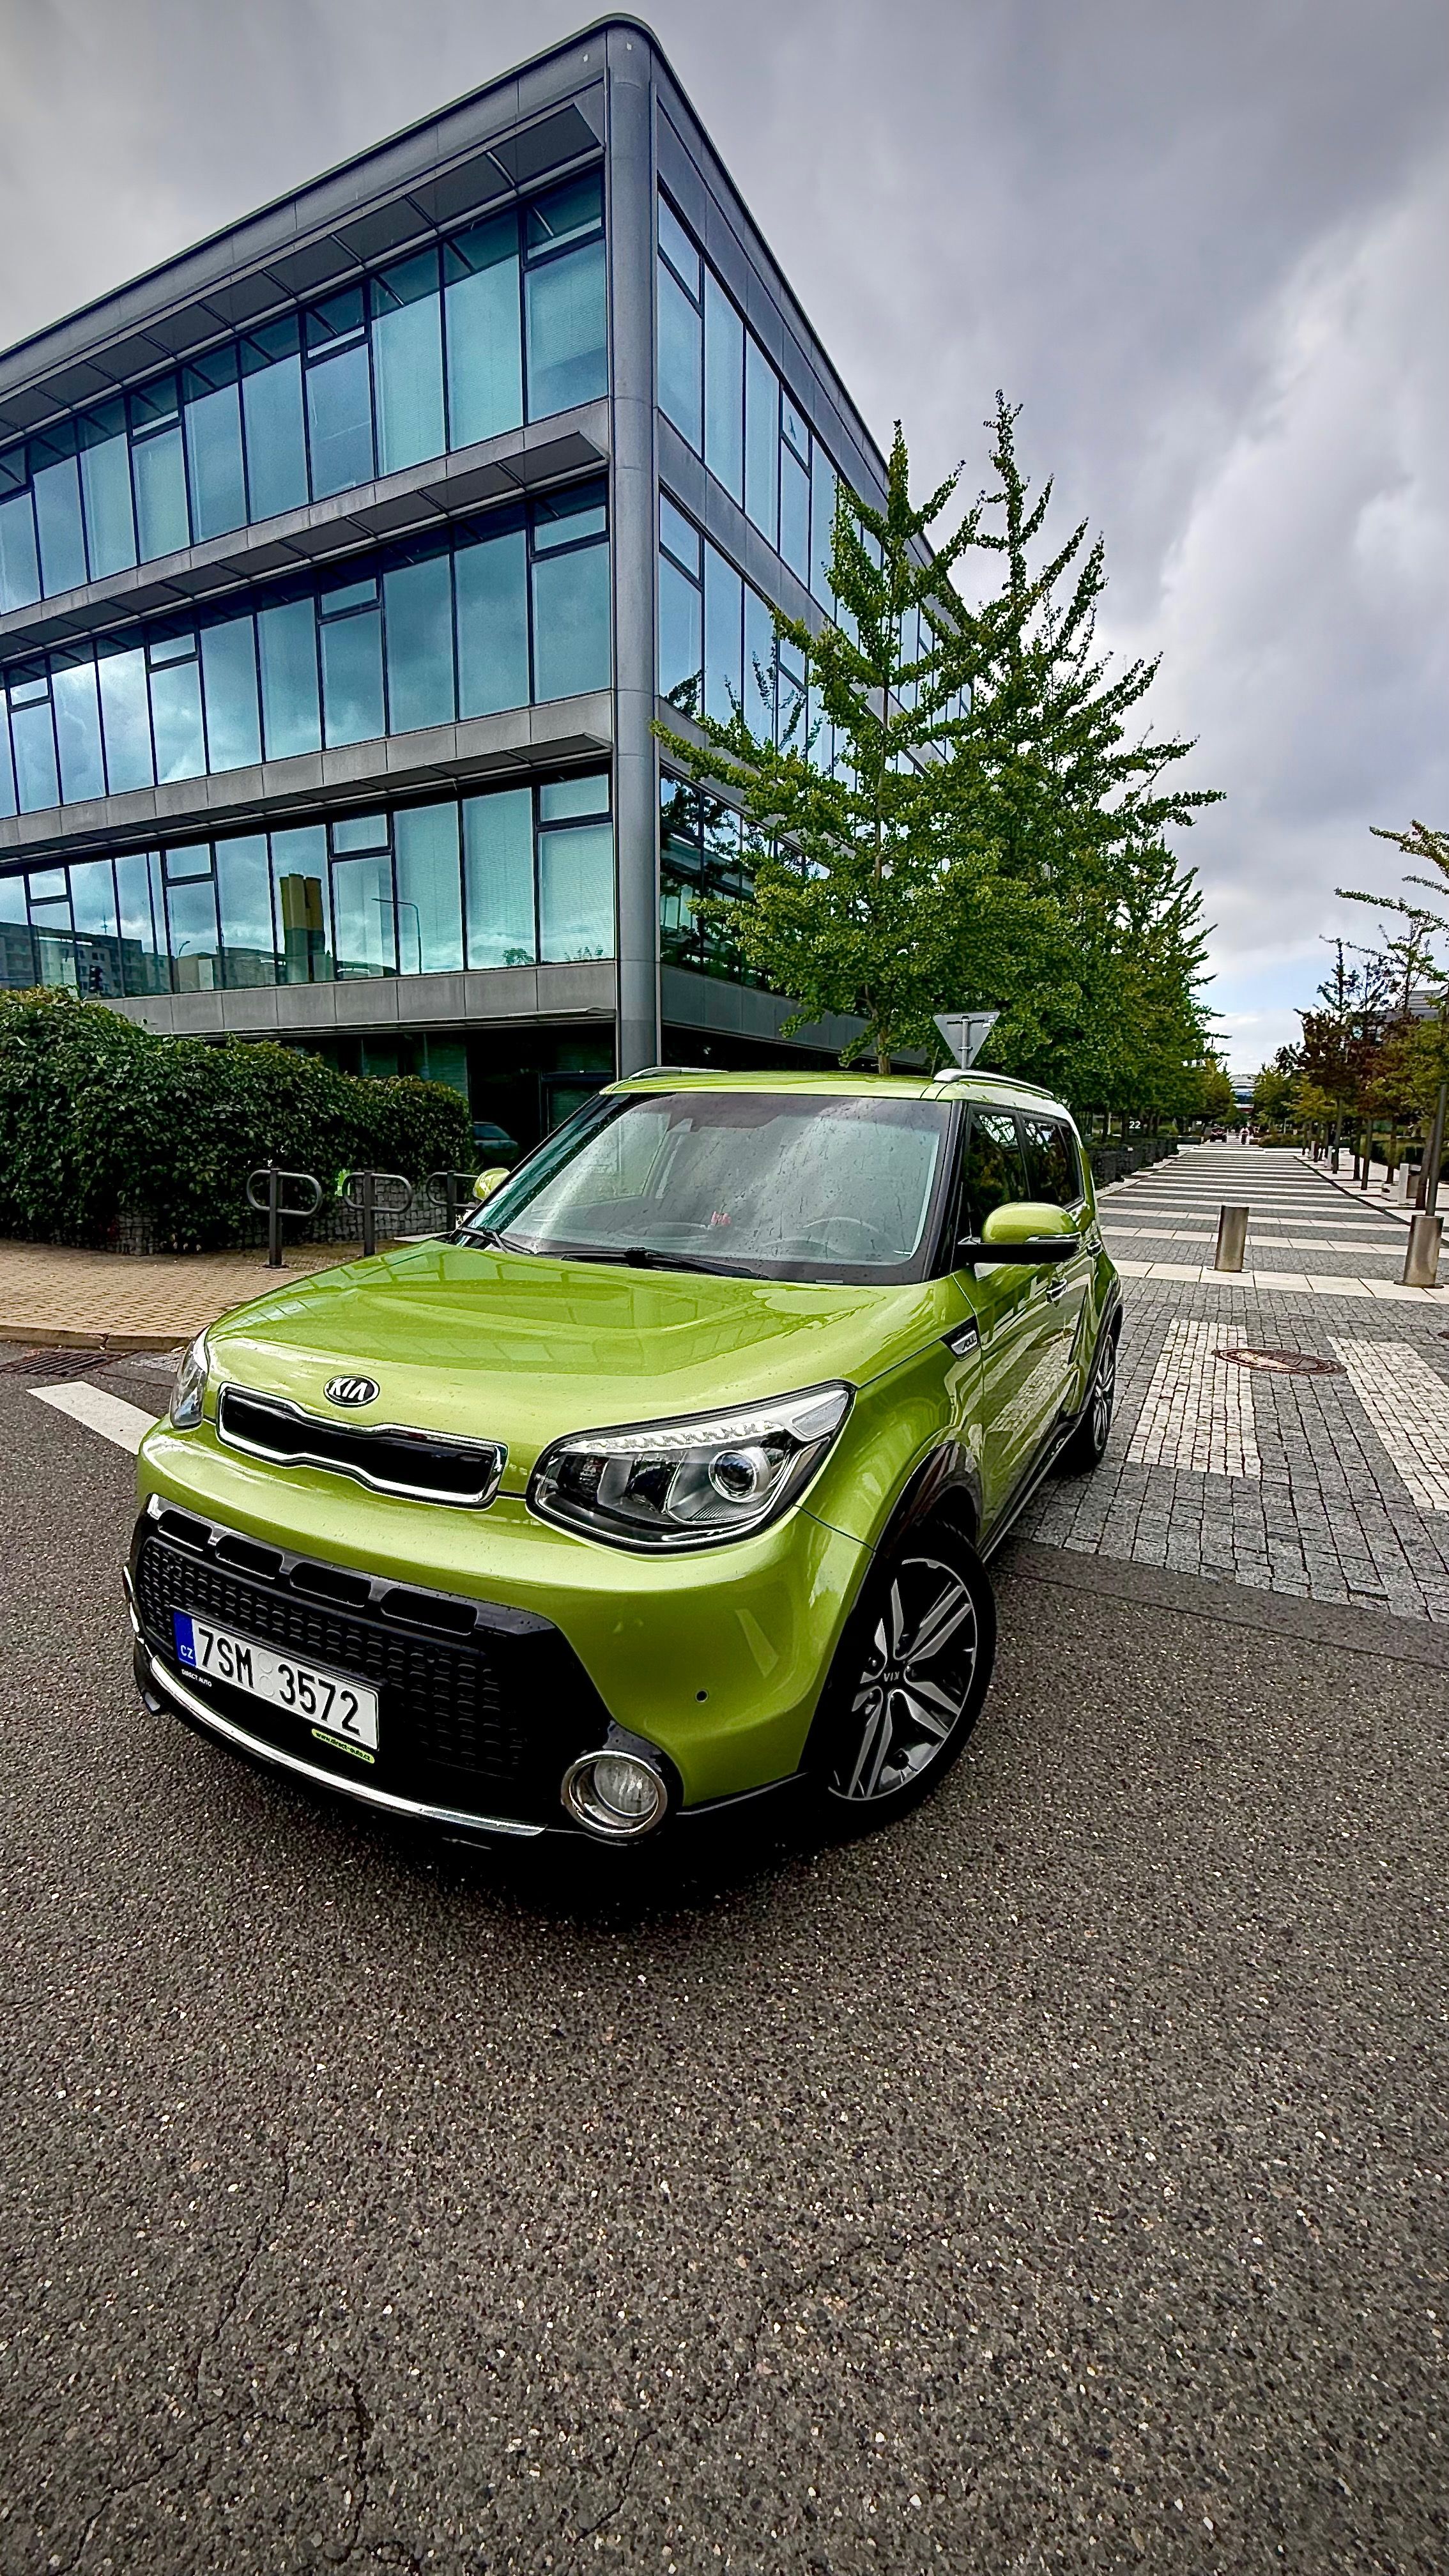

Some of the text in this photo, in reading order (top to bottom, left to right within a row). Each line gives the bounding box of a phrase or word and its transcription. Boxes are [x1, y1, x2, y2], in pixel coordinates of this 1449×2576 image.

[1128, 1121, 1141, 1129] 22
[328, 1377, 368, 1401] KIA
[180, 1644, 194, 1659] CZ
[198, 1627, 360, 1736] 7SM 3572
[199, 1677, 212, 1687] AUTO
